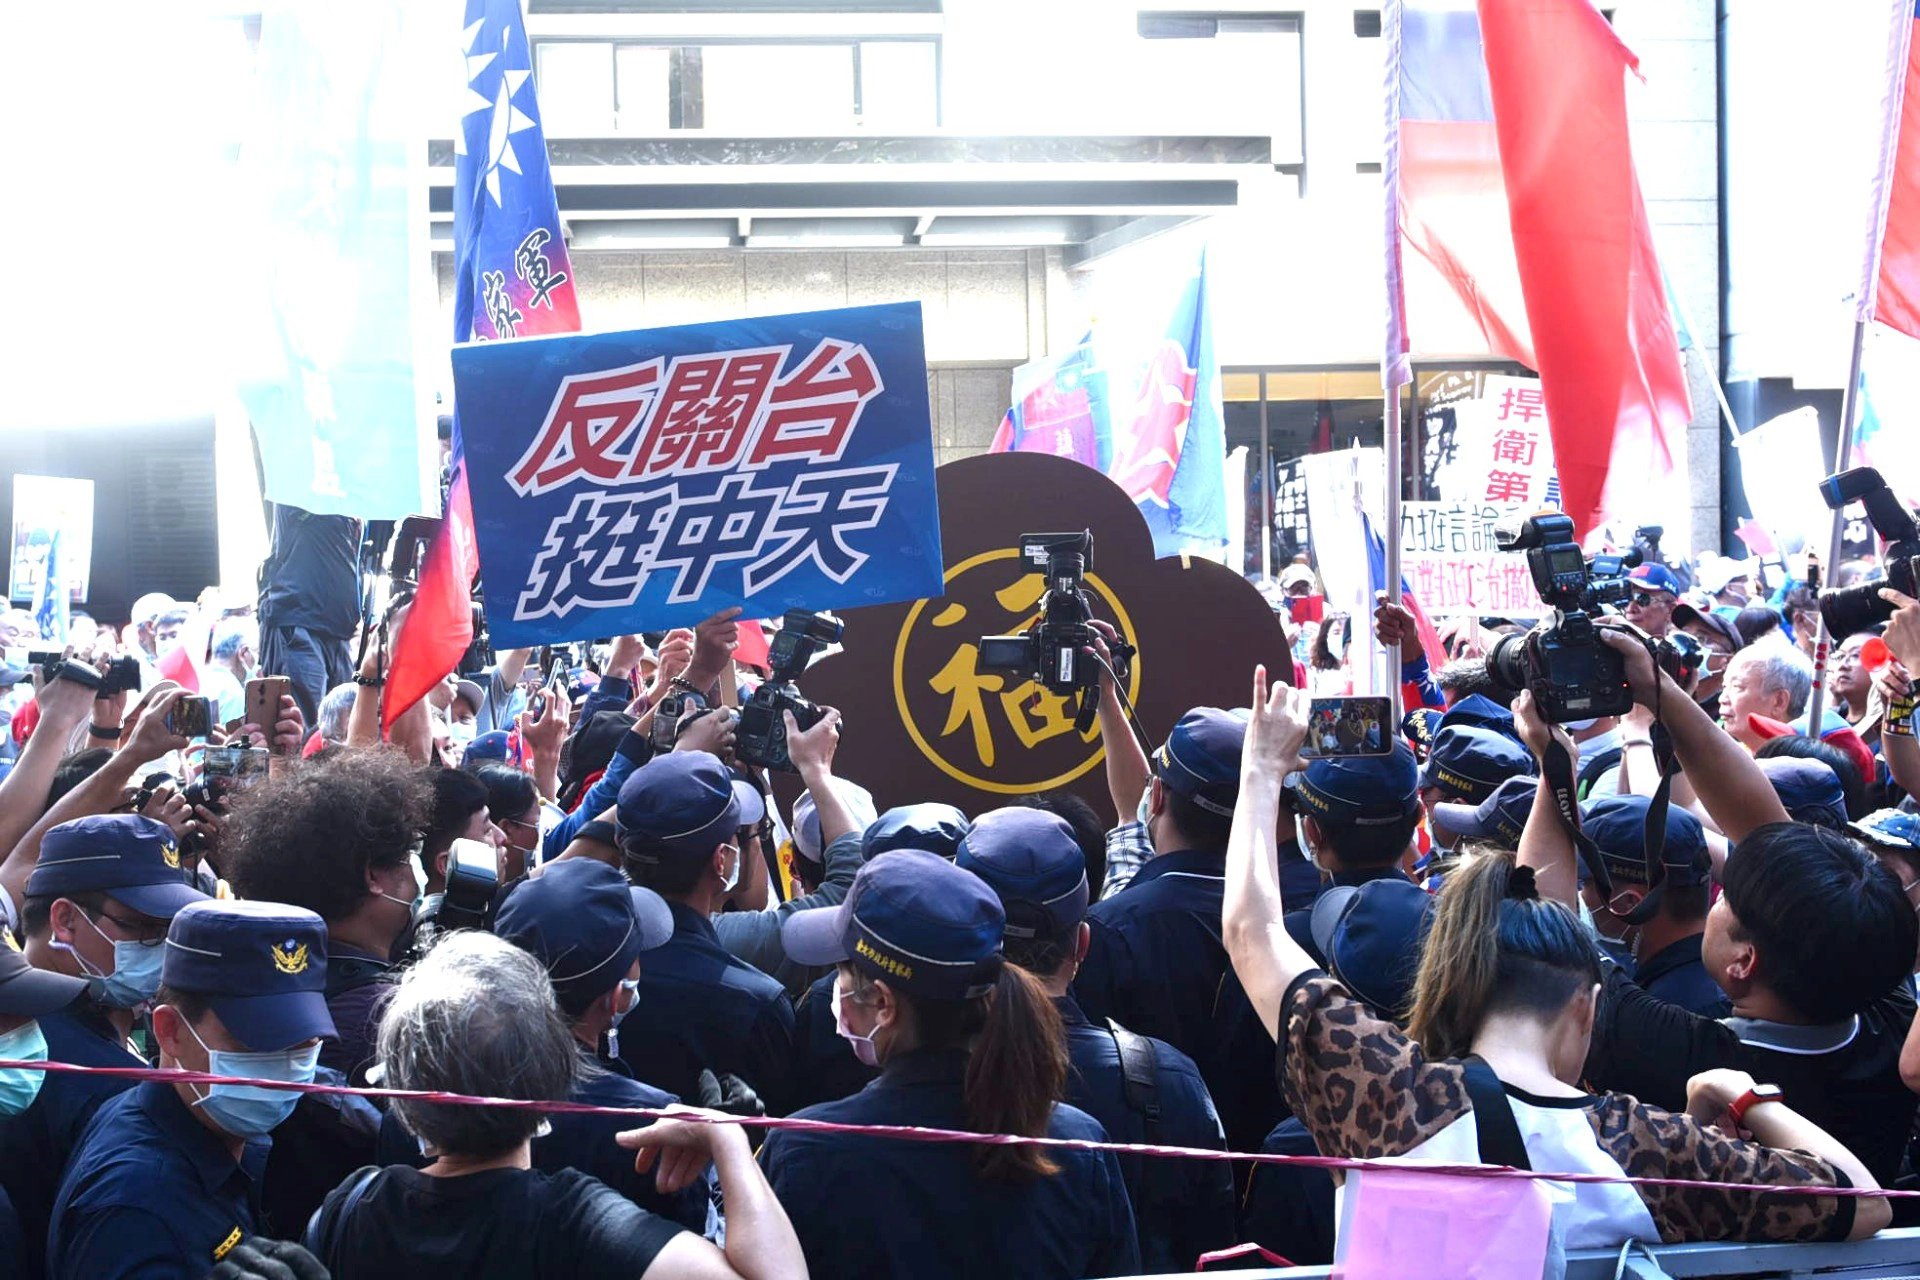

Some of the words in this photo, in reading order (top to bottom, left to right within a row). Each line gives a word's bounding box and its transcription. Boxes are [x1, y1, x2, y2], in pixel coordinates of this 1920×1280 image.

[505, 337, 885, 498] 反關台
[1485, 386, 1545, 503] 捍衛第
[513, 463, 901, 621] 挺中天
[1399, 503, 1522, 553] 力挺言論
